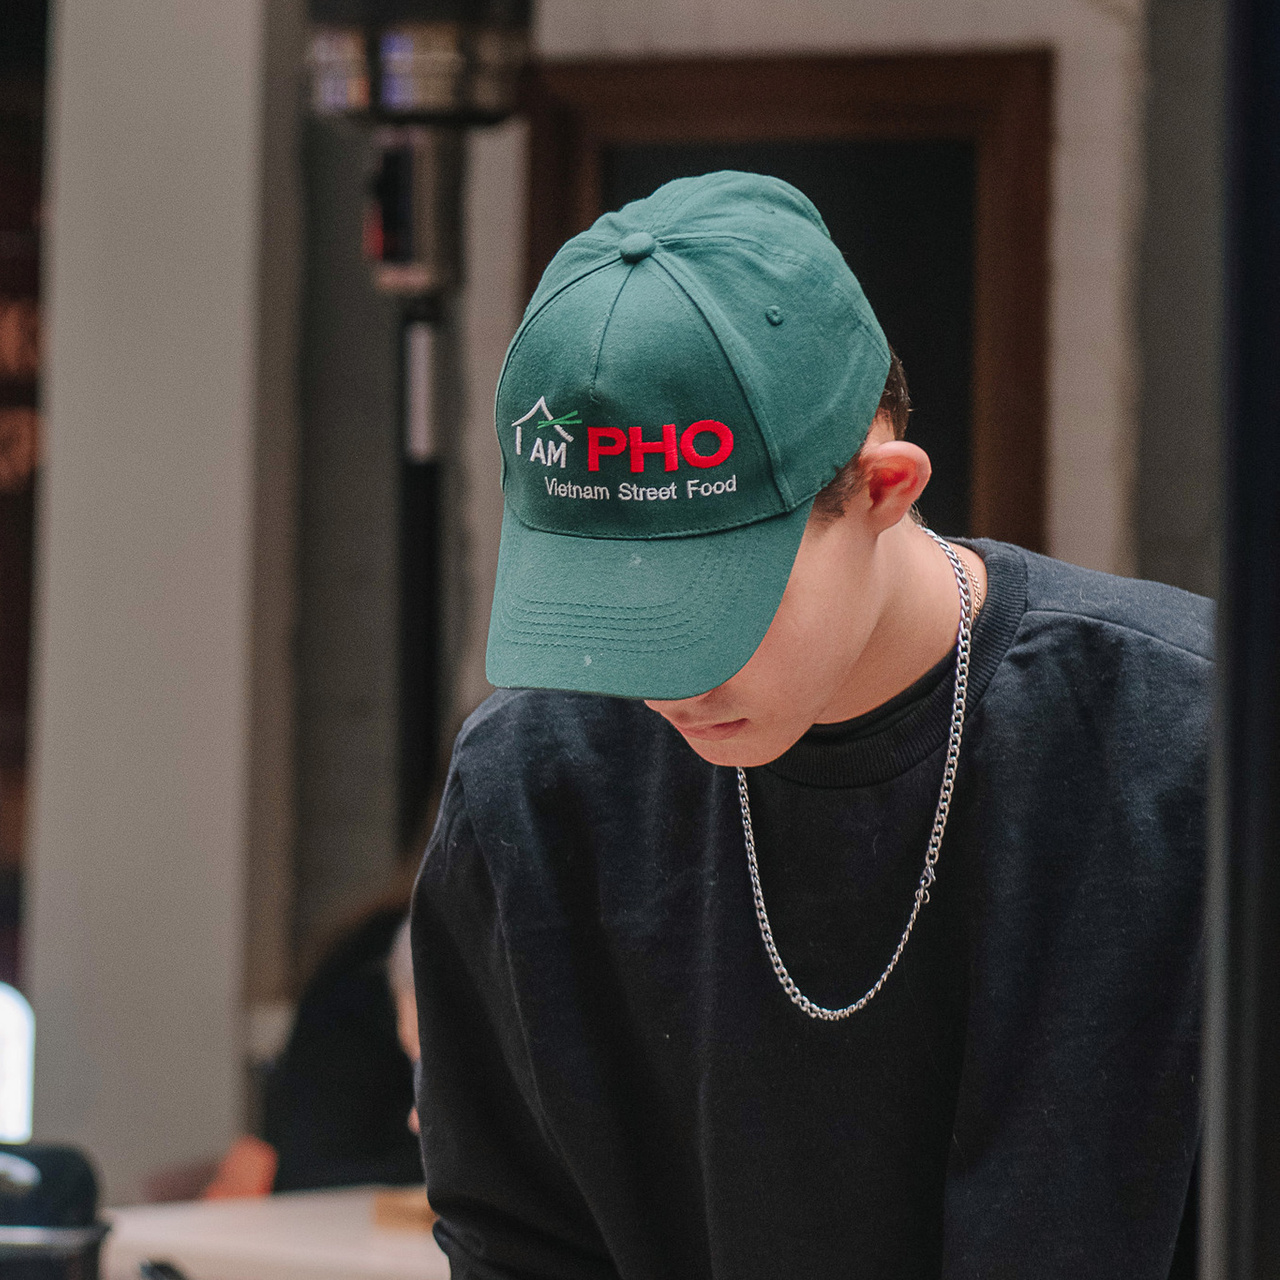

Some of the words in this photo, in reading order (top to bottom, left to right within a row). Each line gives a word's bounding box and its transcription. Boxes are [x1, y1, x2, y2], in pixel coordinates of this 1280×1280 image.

[529, 436, 568, 469] AM
[587, 419, 735, 473] PHO
[543, 475, 611, 501] Vietnam
[617, 482, 678, 502] Street
[686, 474, 738, 500] Food
